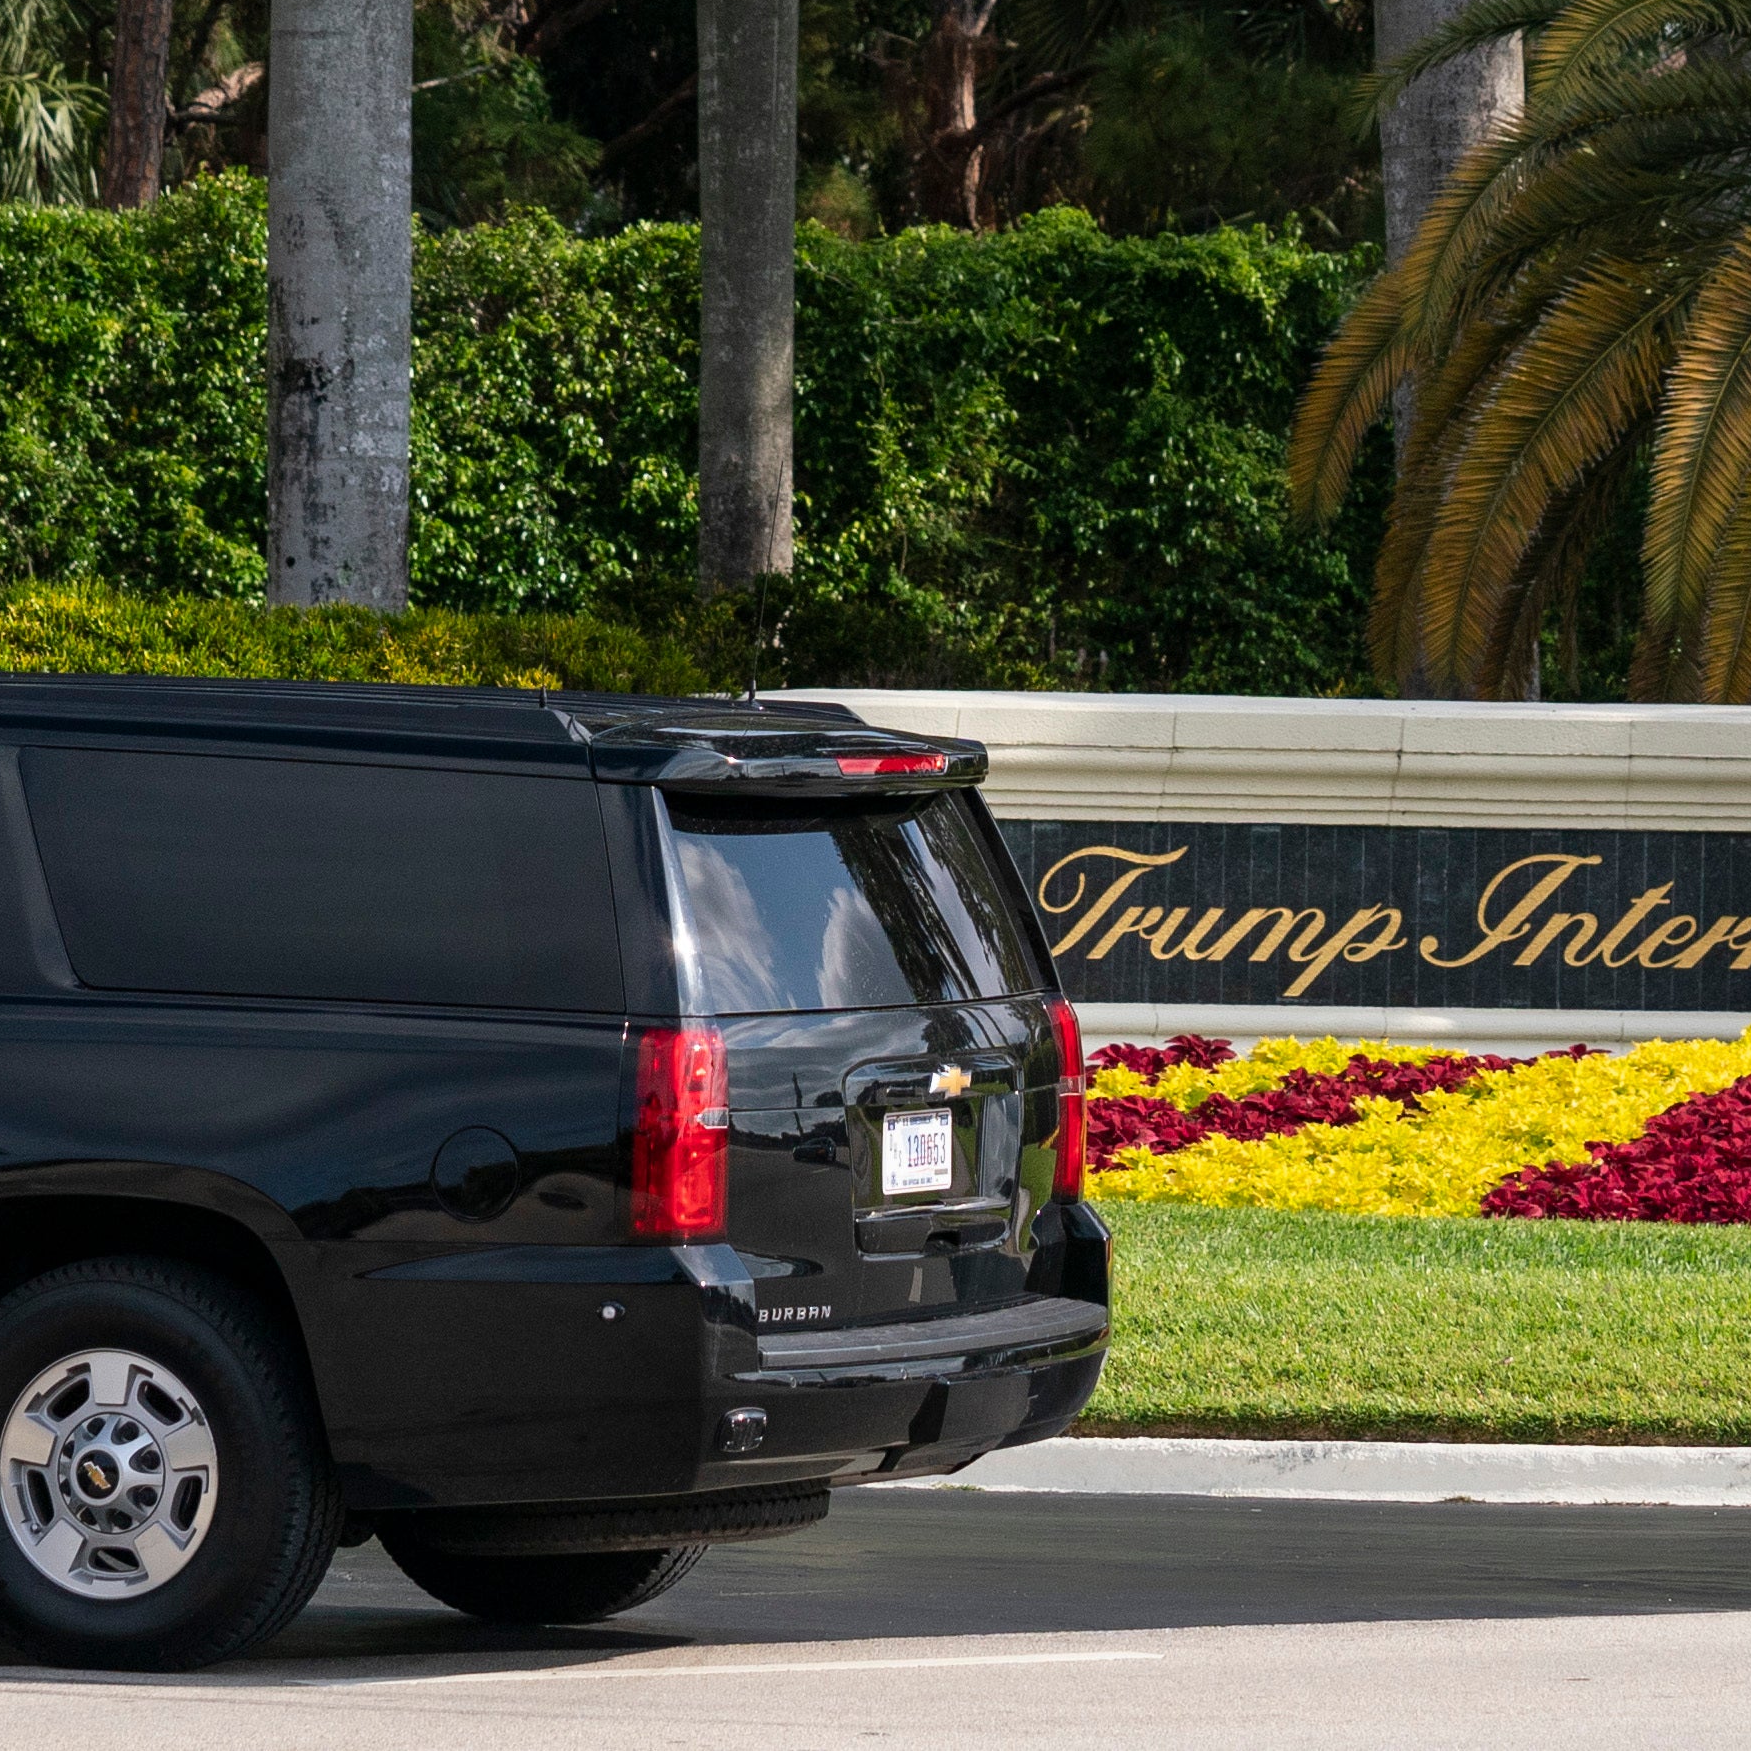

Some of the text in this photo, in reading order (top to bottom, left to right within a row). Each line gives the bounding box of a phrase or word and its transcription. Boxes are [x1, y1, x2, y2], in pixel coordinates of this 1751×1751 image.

[1037, 845, 1409, 999] Trump
[907, 1131, 946, 1168] 130653
[757, 1304, 832, 1323] BURBAN
